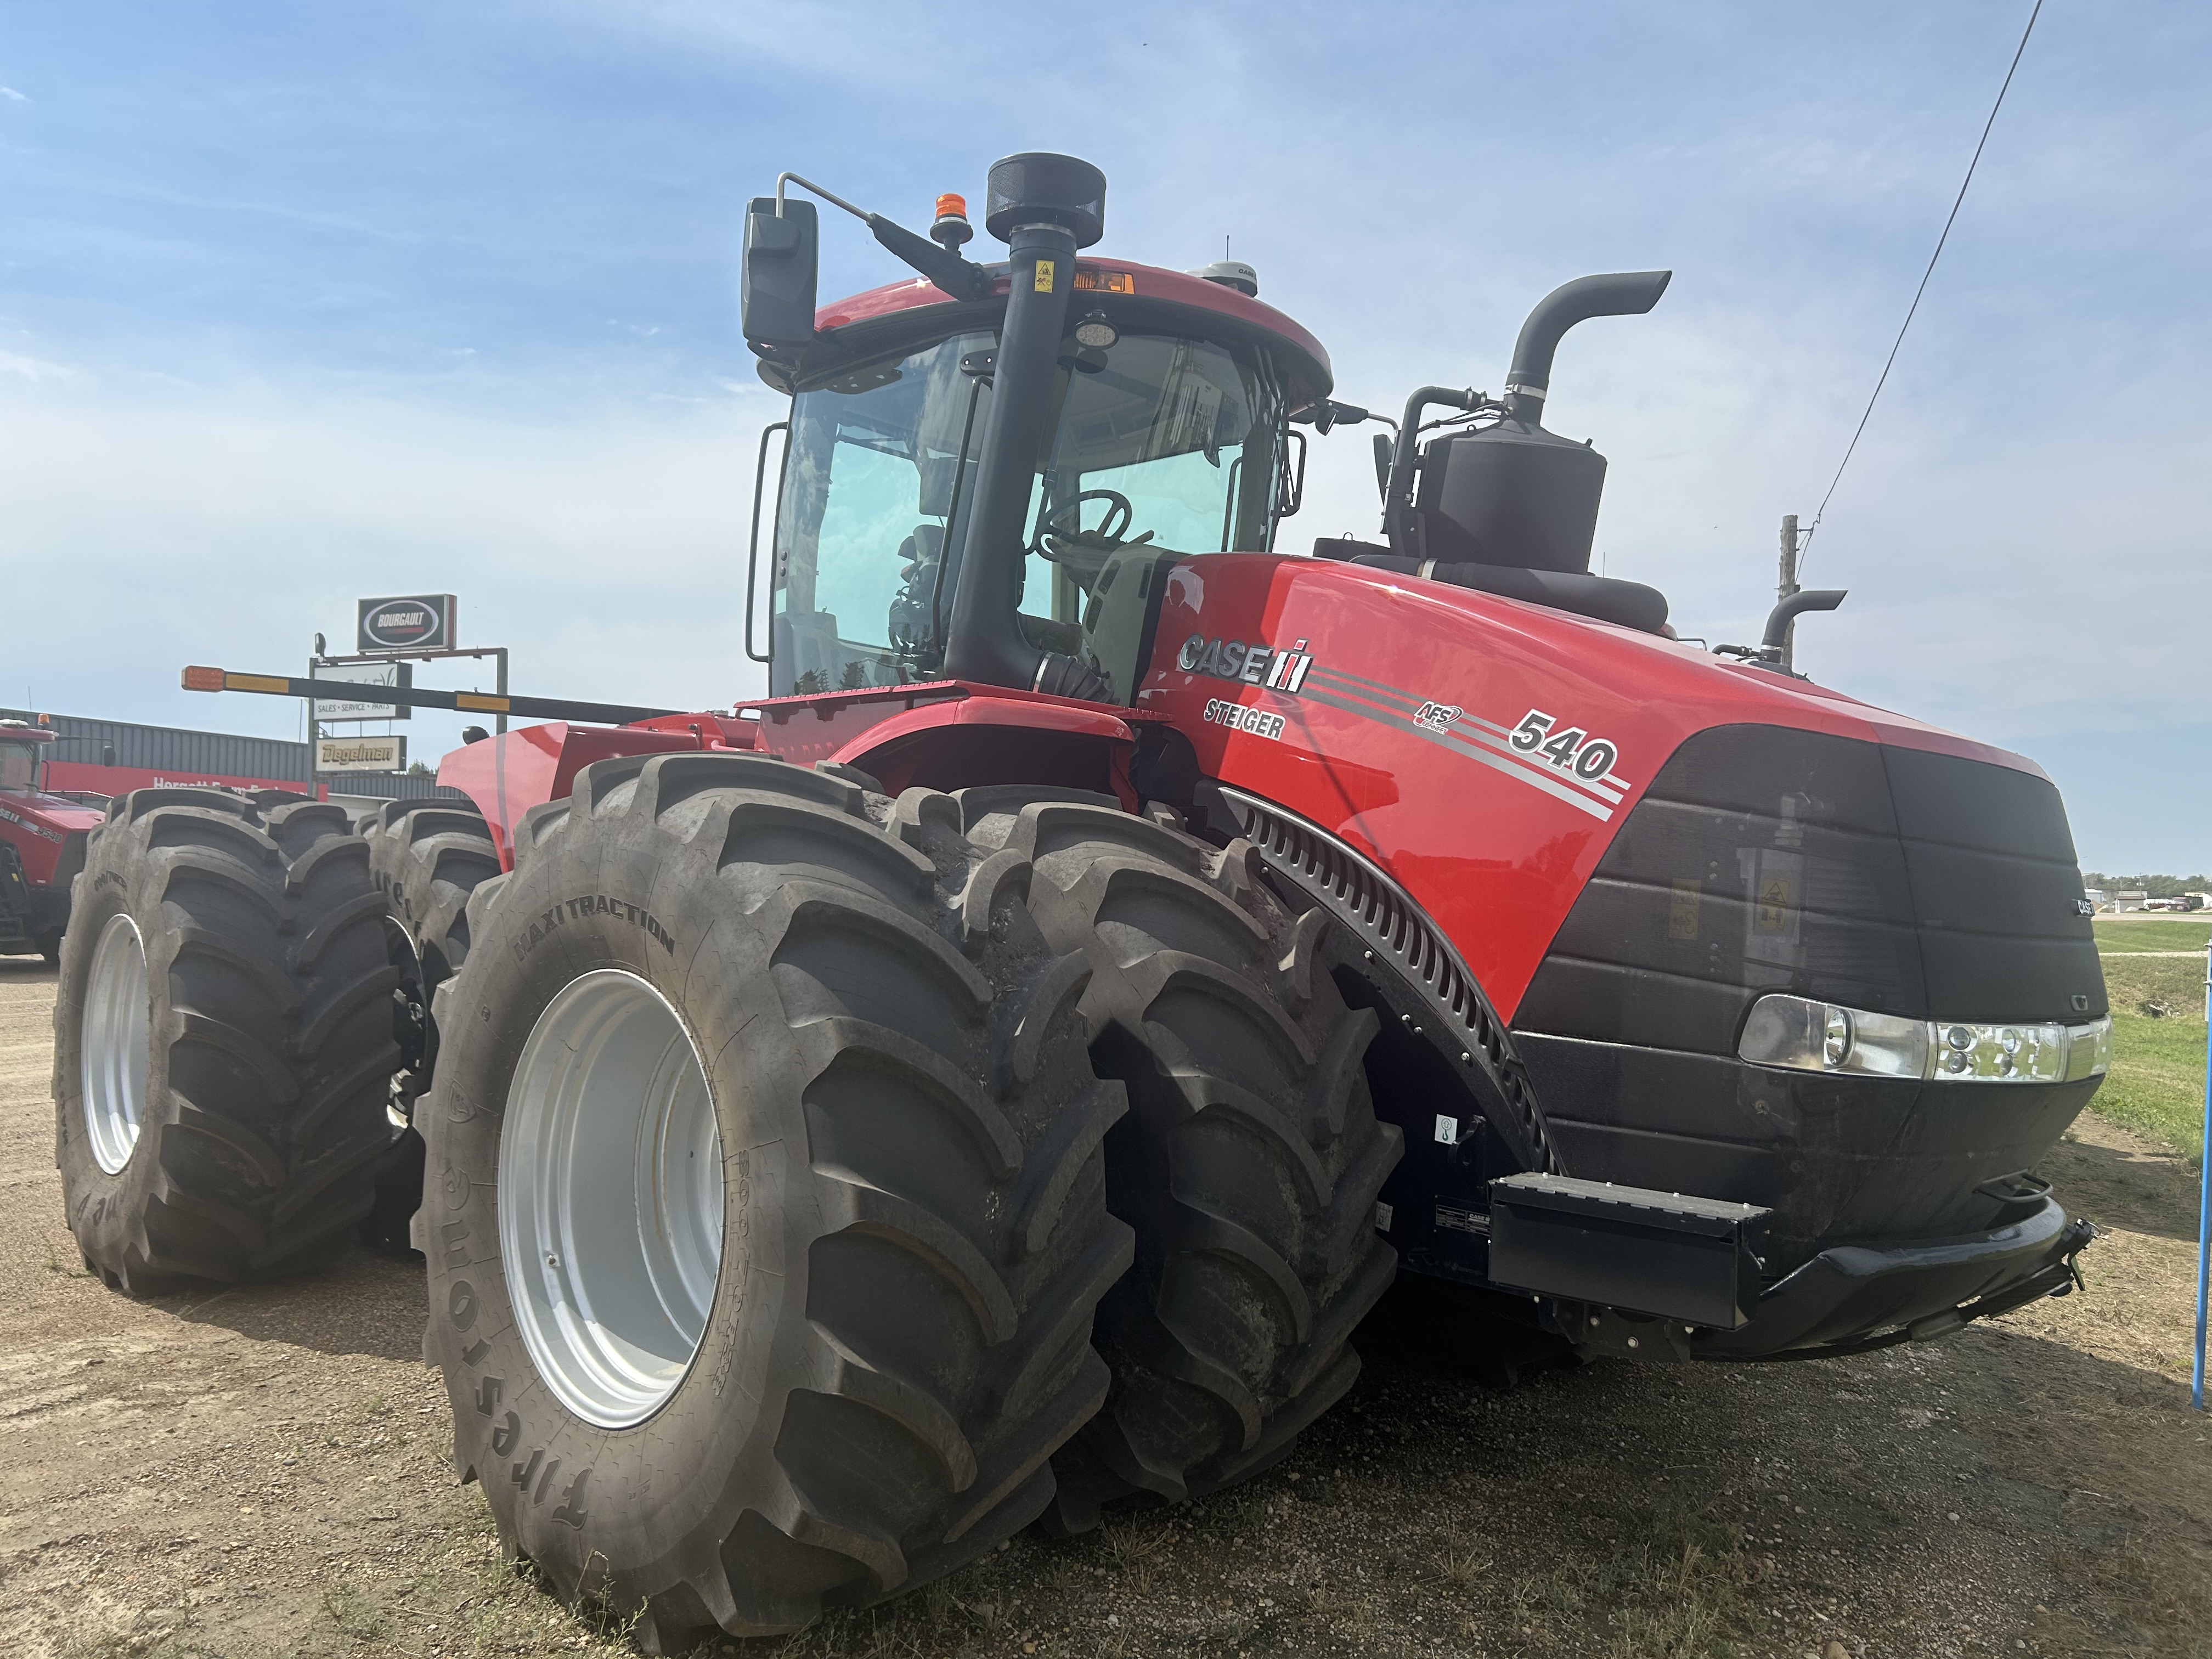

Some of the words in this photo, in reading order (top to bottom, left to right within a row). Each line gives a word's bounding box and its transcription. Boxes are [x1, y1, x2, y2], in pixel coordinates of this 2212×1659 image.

[377, 611, 425, 628] BOURGAULT
[1179, 634, 1273, 685] CASE
[318, 704, 336, 713] SALES
[341, 703, 365, 712] SERVICE
[1203, 697, 1286, 741] STEIGER
[1414, 701, 1454, 724] AFS
[1421, 720, 1449, 735] CONNECT
[323, 743, 393, 765] Degelman
[1508, 708, 1618, 783] 540
[566, 894, 675, 957] TRACTION
